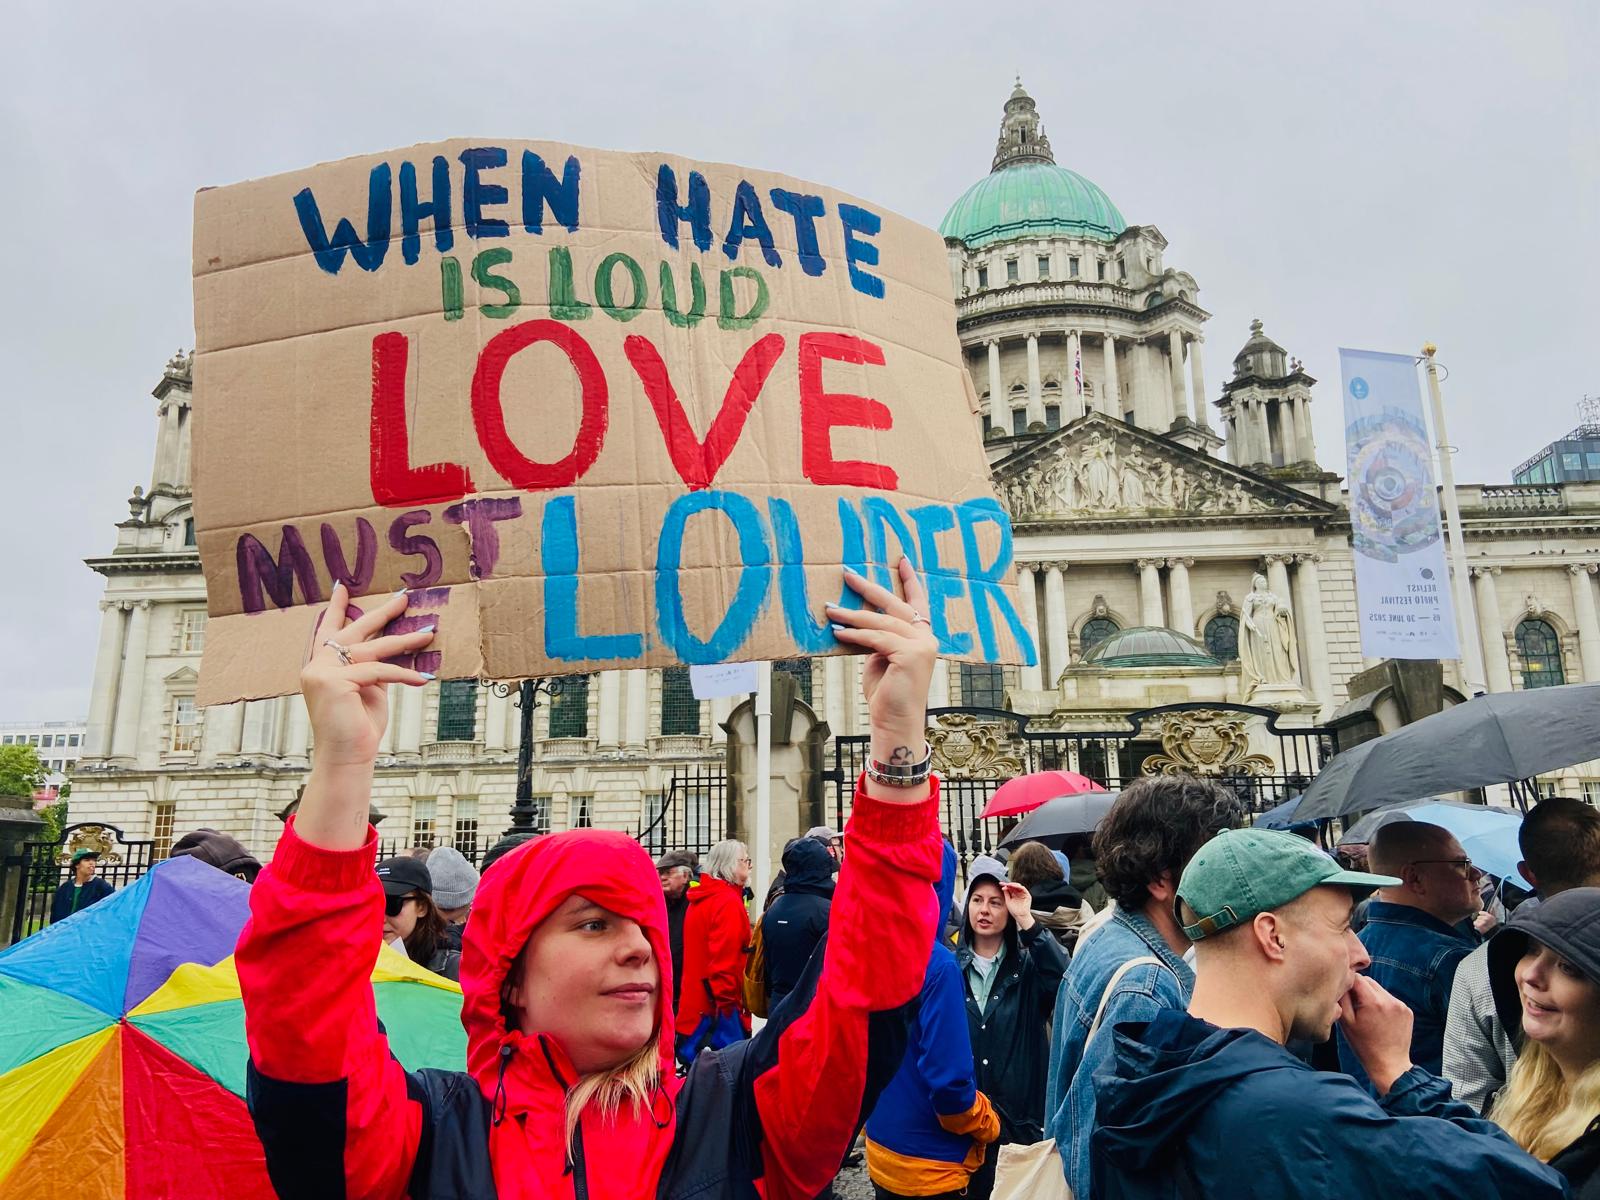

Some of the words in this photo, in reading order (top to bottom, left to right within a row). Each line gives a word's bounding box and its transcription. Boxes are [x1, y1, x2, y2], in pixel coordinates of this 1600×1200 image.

[293, 147, 582, 275] WHEN
[656, 163, 887, 299] HATE
[441, 247, 521, 321] IS
[548, 246, 770, 331] LOUD
[370, 318, 899, 508] LOVE
[1528, 446, 1552, 466] CENTRAL
[236, 496, 523, 616] MUST
[541, 490, 1039, 667] LOUDER
[310, 587, 452, 676] E
